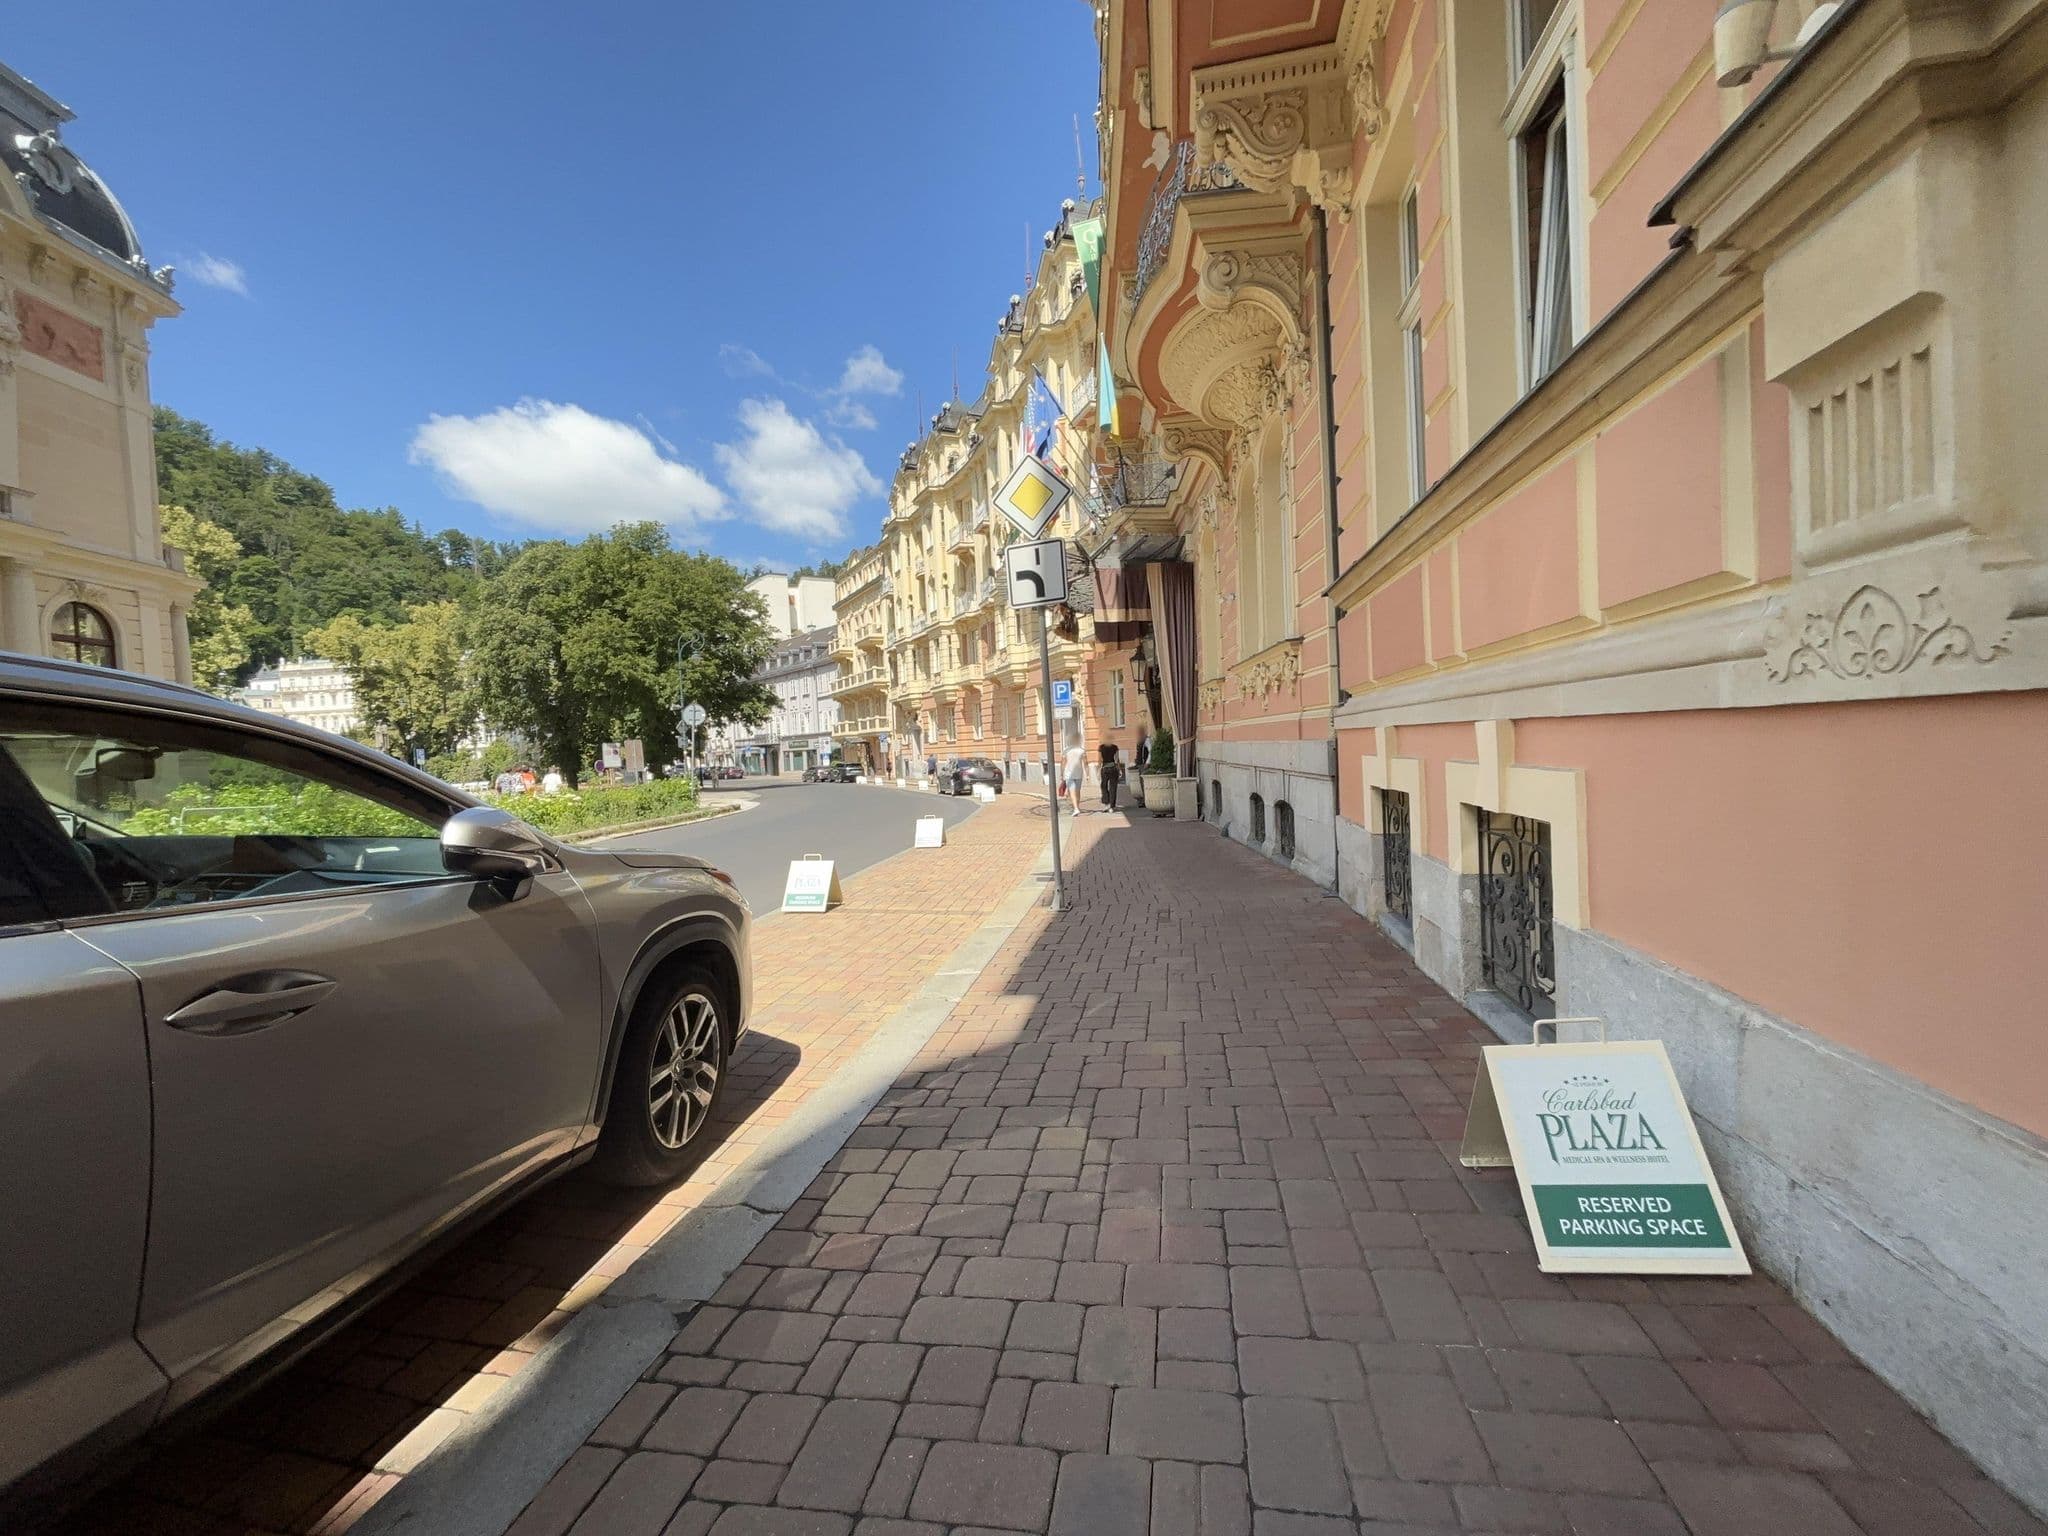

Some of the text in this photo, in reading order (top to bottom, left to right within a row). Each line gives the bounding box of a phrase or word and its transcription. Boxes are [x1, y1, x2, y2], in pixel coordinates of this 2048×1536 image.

[1056, 684, 1067, 699] P
[1543, 1088, 1637, 1113] Carlsbad
[1536, 1112, 1667, 1167] PLAZA
[1577, 1197, 1672, 1213] RESERVED
[1559, 1218, 1708, 1235] PARKING SPACE
